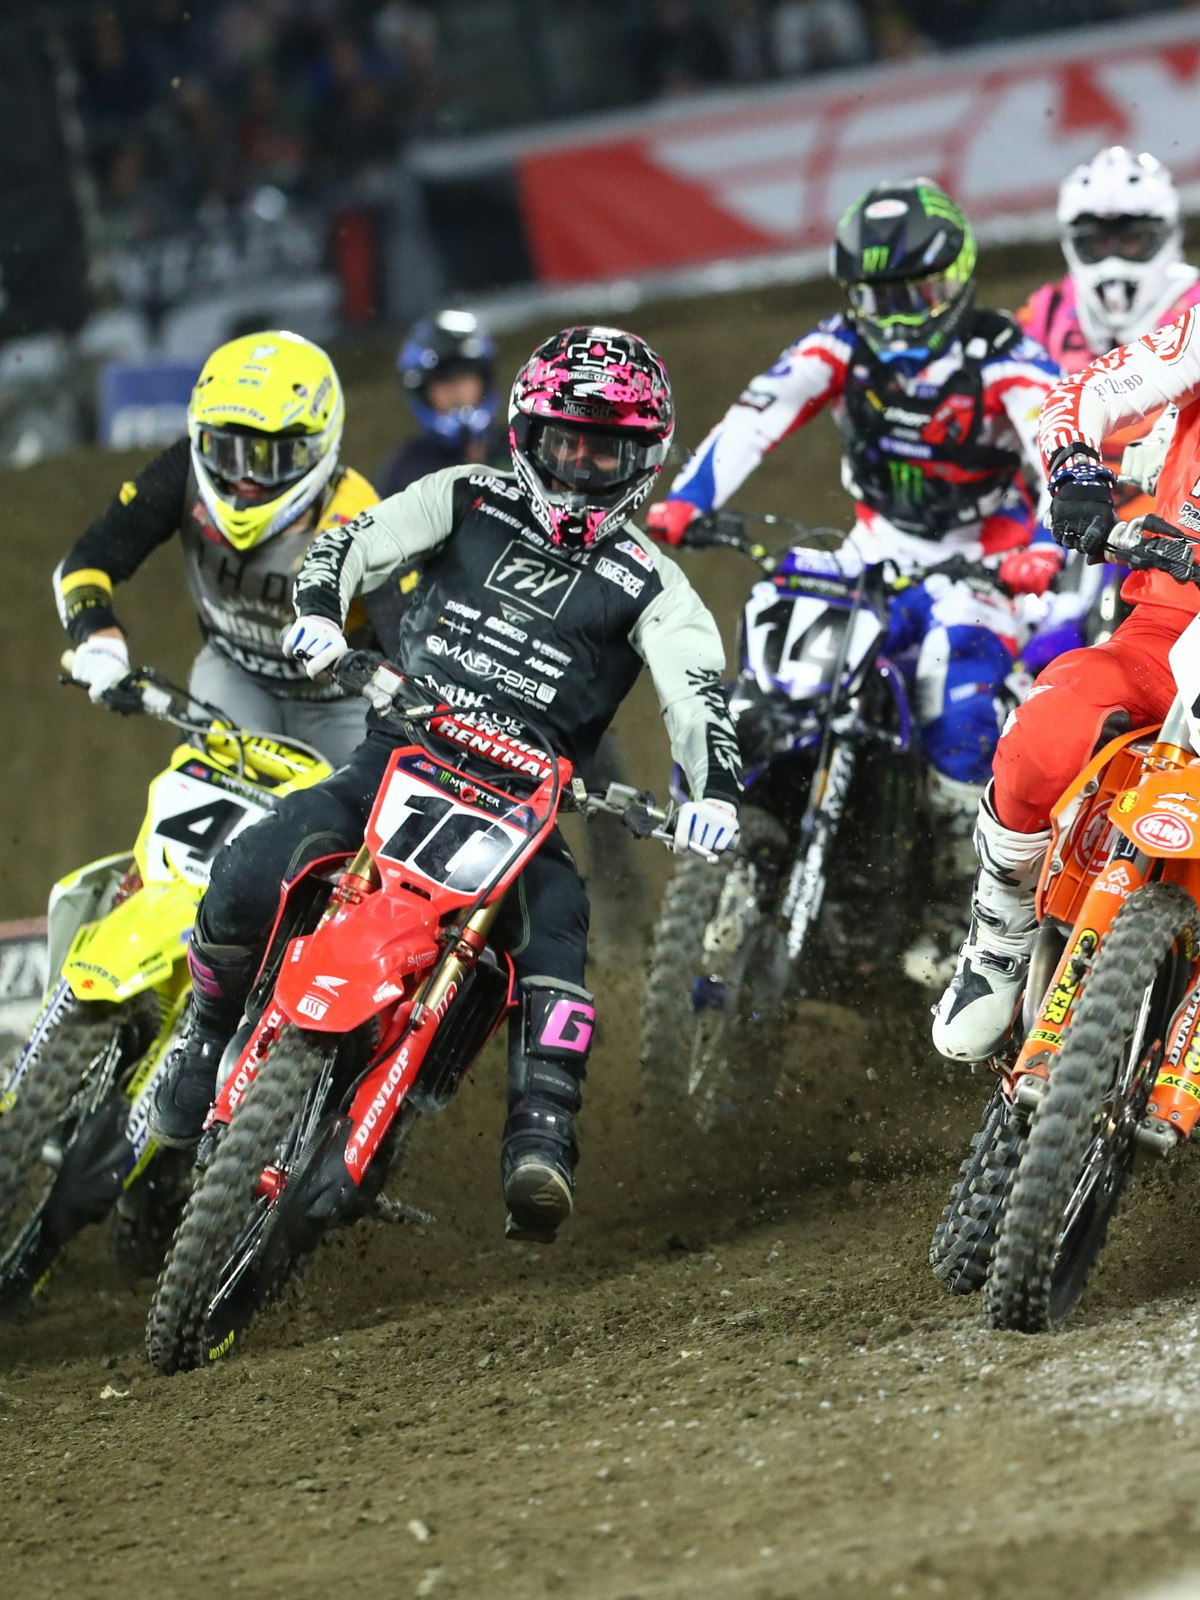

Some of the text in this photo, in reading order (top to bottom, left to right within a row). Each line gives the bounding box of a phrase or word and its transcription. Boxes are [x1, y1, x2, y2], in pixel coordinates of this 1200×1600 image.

[444, 600, 482, 620] SHOWA
[497, 558, 569, 598] FLY
[754, 598, 853, 686] 14
[378, 793, 514, 894] 10
[354, 1048, 409, 1147] DUNLOP
